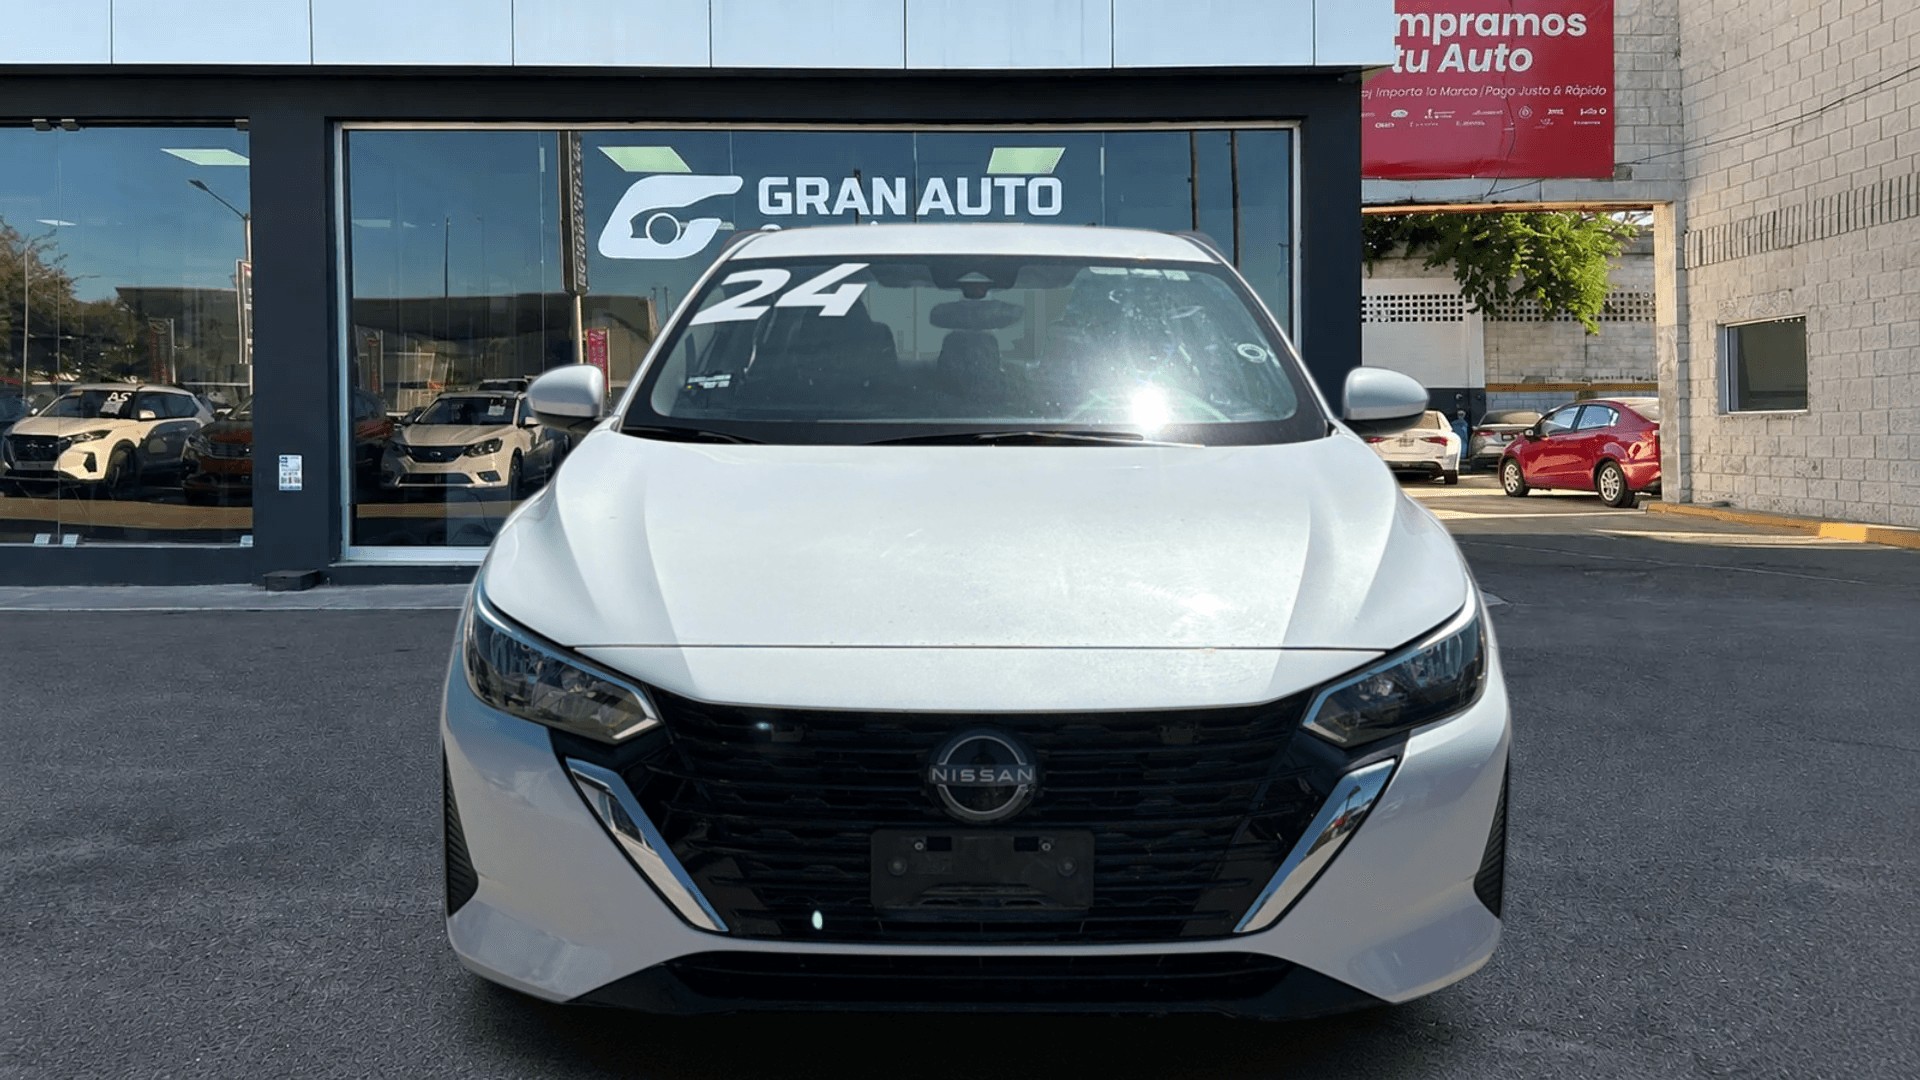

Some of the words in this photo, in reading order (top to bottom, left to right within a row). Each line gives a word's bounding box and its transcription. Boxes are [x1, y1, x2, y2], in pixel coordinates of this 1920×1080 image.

[1392, 44, 1430, 73] tu
[1437, 43, 1533, 72] Auto
[1376, 87, 1423, 99] Importa
[1519, 86, 1551, 97] Justo
[1553, 85, 1561, 96] &
[1565, 84, 1607, 98] Rápido
[758, 176, 907, 216] GRAN
[916, 177, 1063, 216] AUTO
[688, 262, 870, 326] 24
[931, 768, 1034, 782] NISSAN
